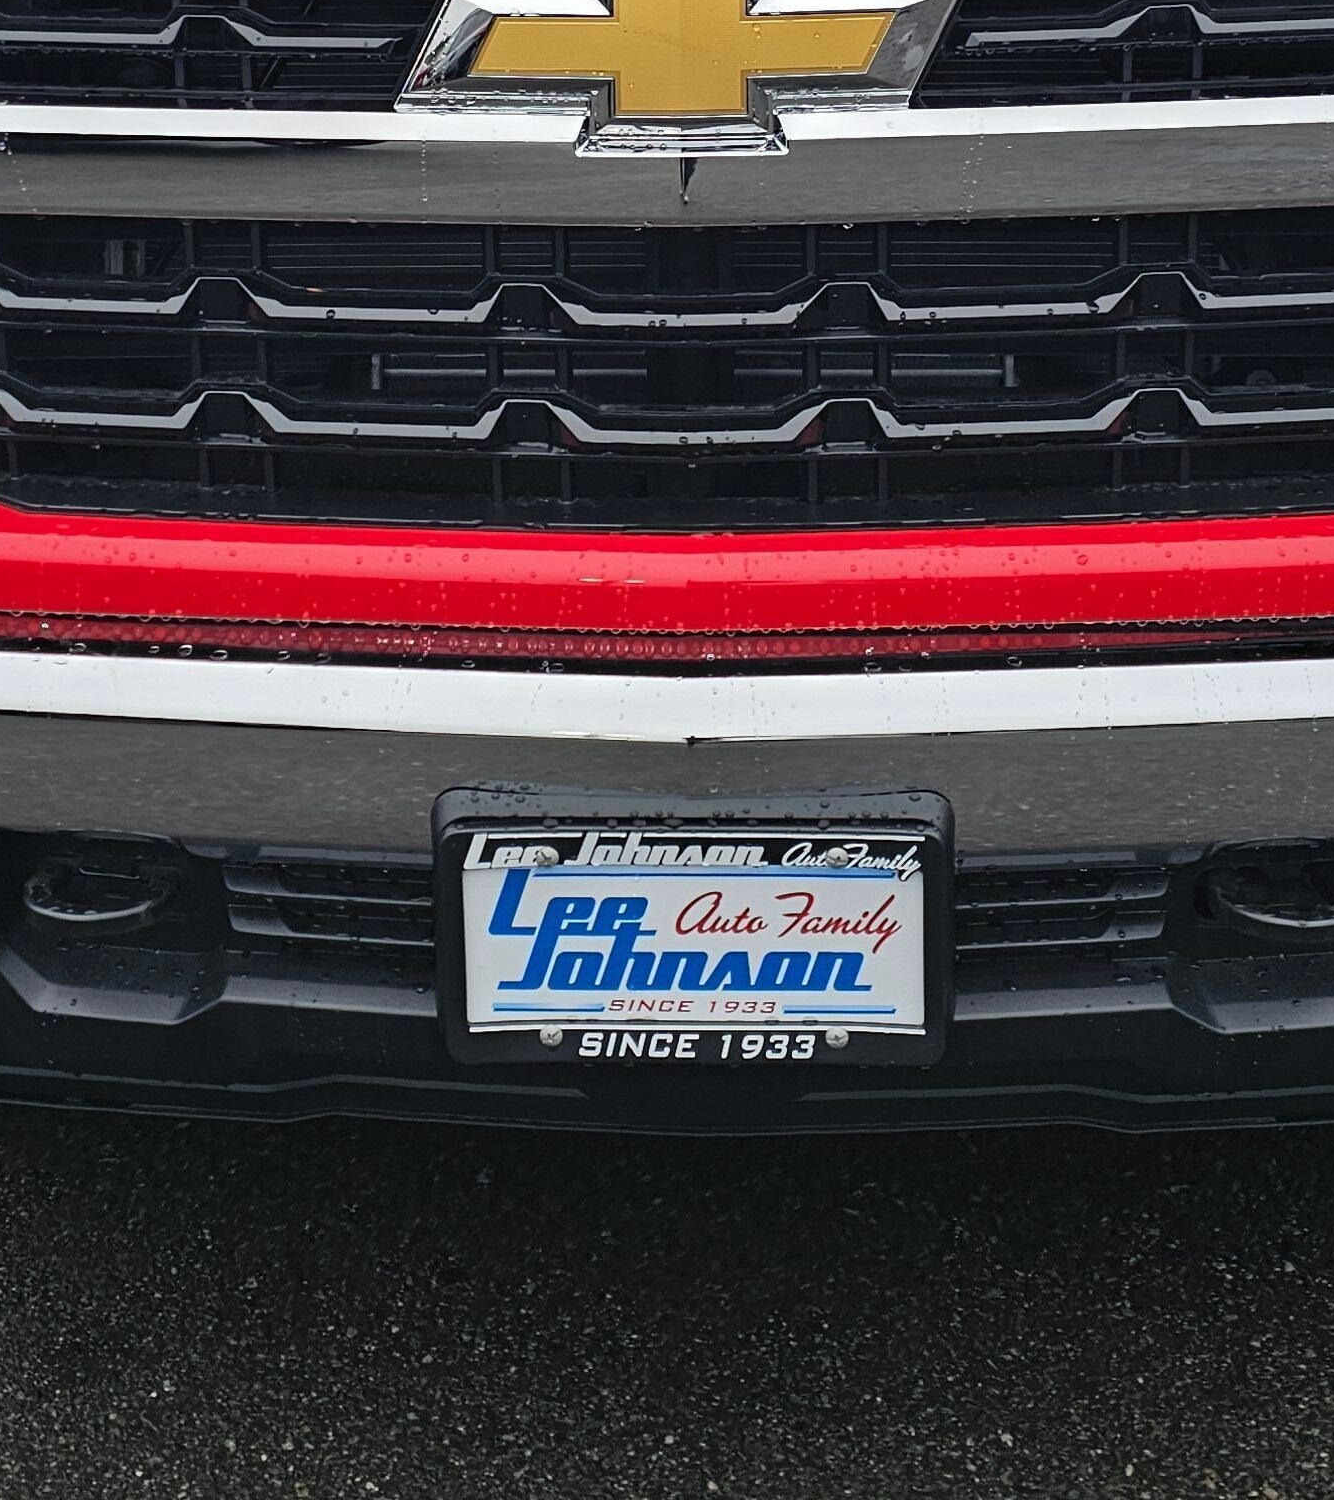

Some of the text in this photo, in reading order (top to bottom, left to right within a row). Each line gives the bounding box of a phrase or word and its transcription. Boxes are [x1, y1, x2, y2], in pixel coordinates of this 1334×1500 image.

[564, 832, 768, 867] Johnson
[781, 842, 832, 868] Aut
[842, 843, 922, 881] Family
[488, 869, 902, 954] Lee Auto Family
[497, 924, 872, 992] Johnson
[608, 999, 777, 1014] SINCE 1933
[578, 1032, 816, 1060] SINCE 1933
